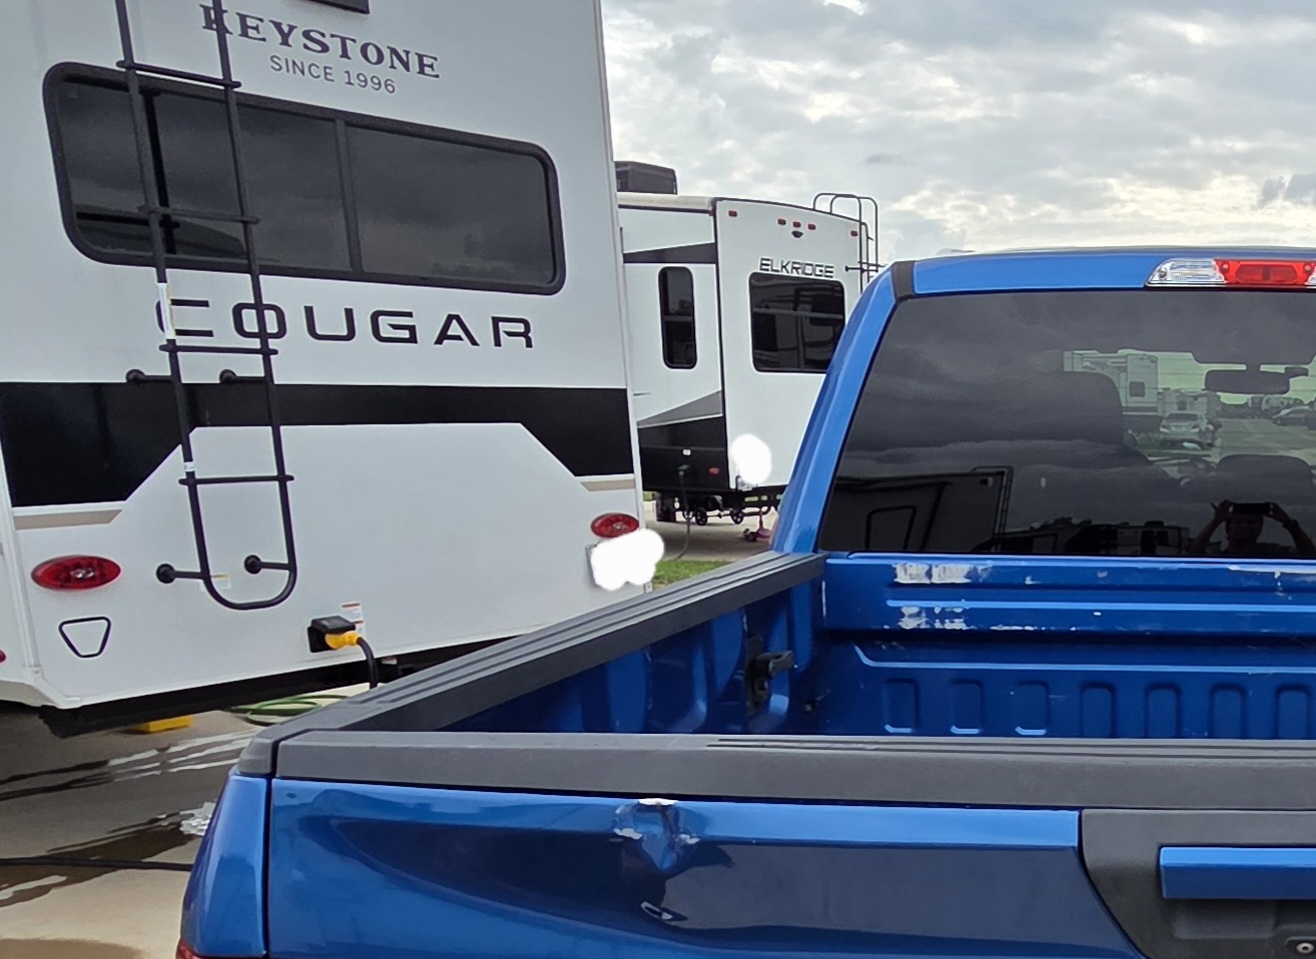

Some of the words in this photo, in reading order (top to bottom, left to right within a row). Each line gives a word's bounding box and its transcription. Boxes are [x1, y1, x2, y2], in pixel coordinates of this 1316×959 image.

[200, 4, 440, 79] KEYSTONE
[270, 55, 335, 82] SINCE
[344, 70, 396, 94] 1996
[759, 257, 834, 278] ELKRIDGE
[155, 299, 533, 349] COUGAR
